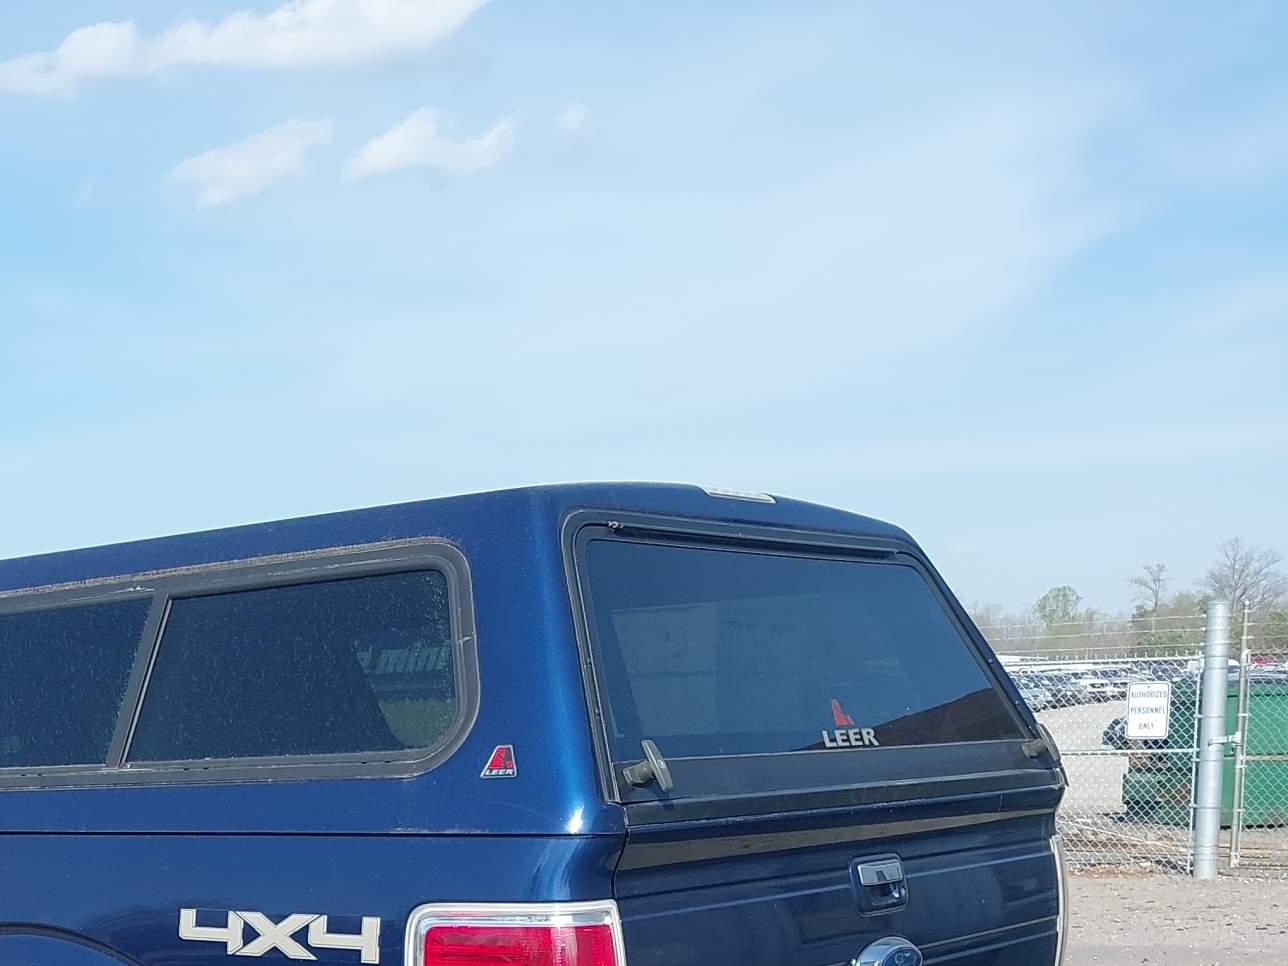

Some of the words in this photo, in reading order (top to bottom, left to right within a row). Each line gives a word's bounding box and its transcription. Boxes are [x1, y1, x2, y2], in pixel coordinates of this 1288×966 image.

[1130, 691, 1168, 699] AUTHORIZED
[1130, 706, 1166, 714] PERSONNEL
[1138, 722, 1155, 730] ONLY
[821, 727, 880, 748] LEER
[485, 768, 514, 776] LEER
